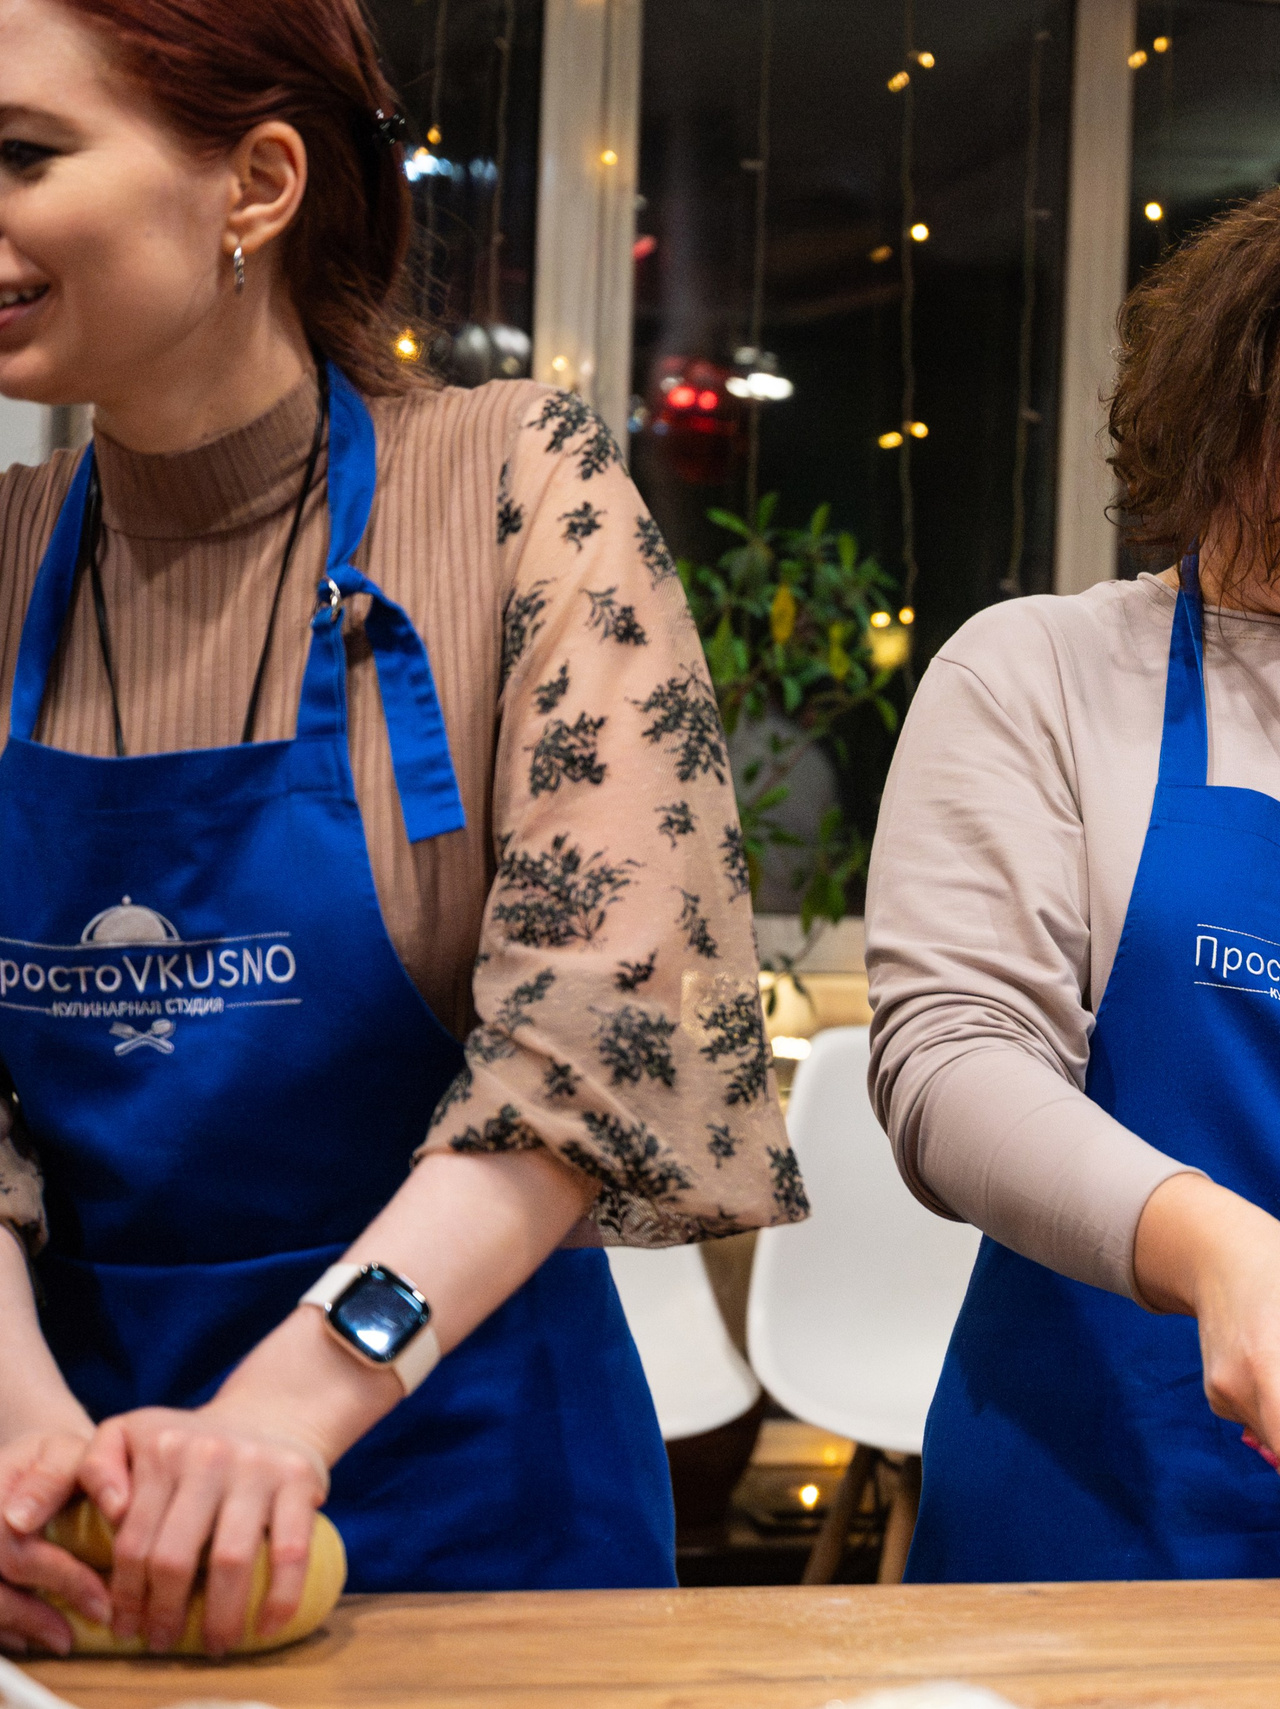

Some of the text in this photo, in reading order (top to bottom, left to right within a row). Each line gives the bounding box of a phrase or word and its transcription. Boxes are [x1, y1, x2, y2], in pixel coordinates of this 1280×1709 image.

[0, 944, 297, 997] ростоVKUSNO
[51, 996, 225, 1018] КУЛИНАРНАЯ СТУДИЯ
